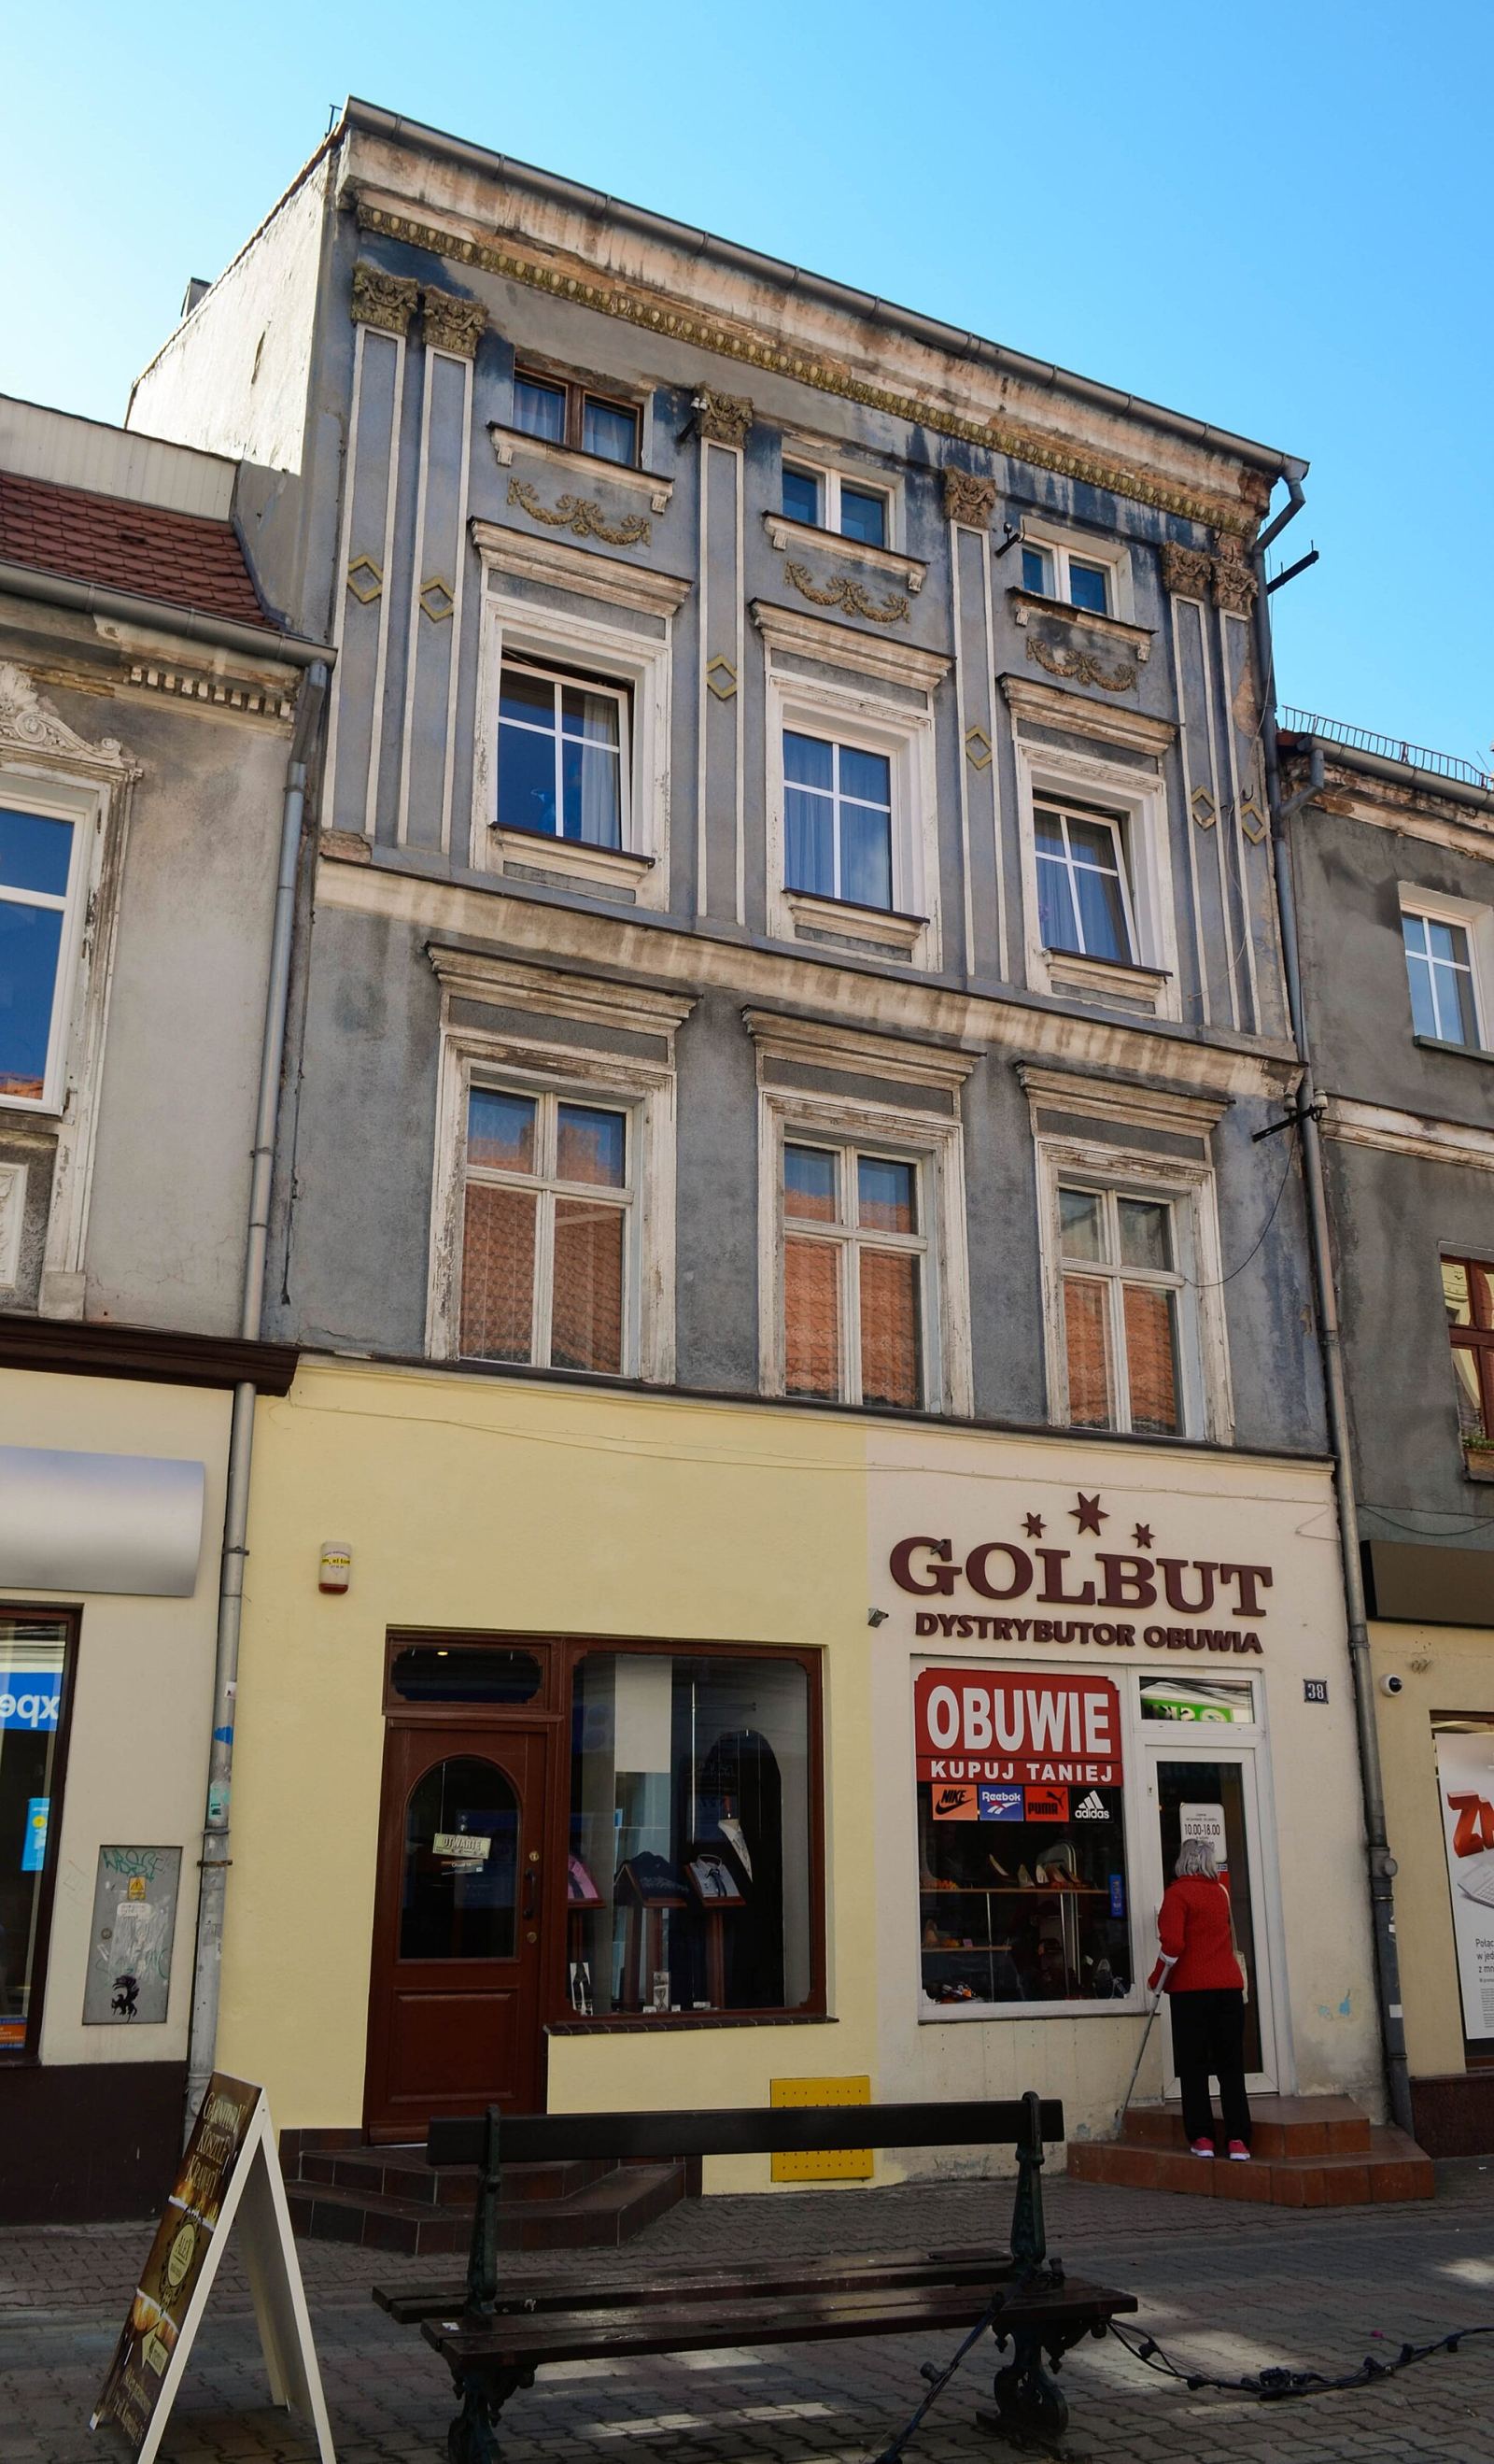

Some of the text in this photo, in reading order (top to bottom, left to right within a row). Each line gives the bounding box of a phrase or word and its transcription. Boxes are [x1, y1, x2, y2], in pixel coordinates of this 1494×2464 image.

[889, 1536, 1273, 1617] GOLBUT
[915, 1612, 1263, 1654] DYSTRYBUTOR OBUWIA
[1307, 1683, 1324, 1699] 38
[927, 1685, 1112, 1754] OBUWIE
[931, 1761, 1112, 1782] KUPUJ TANIEJ
[941, 1790, 966, 1804] NIKE
[982, 1791, 1021, 1803] Reebok
[1028, 1803, 1058, 1815] PUMA
[1075, 1808, 1110, 1820] adidas
